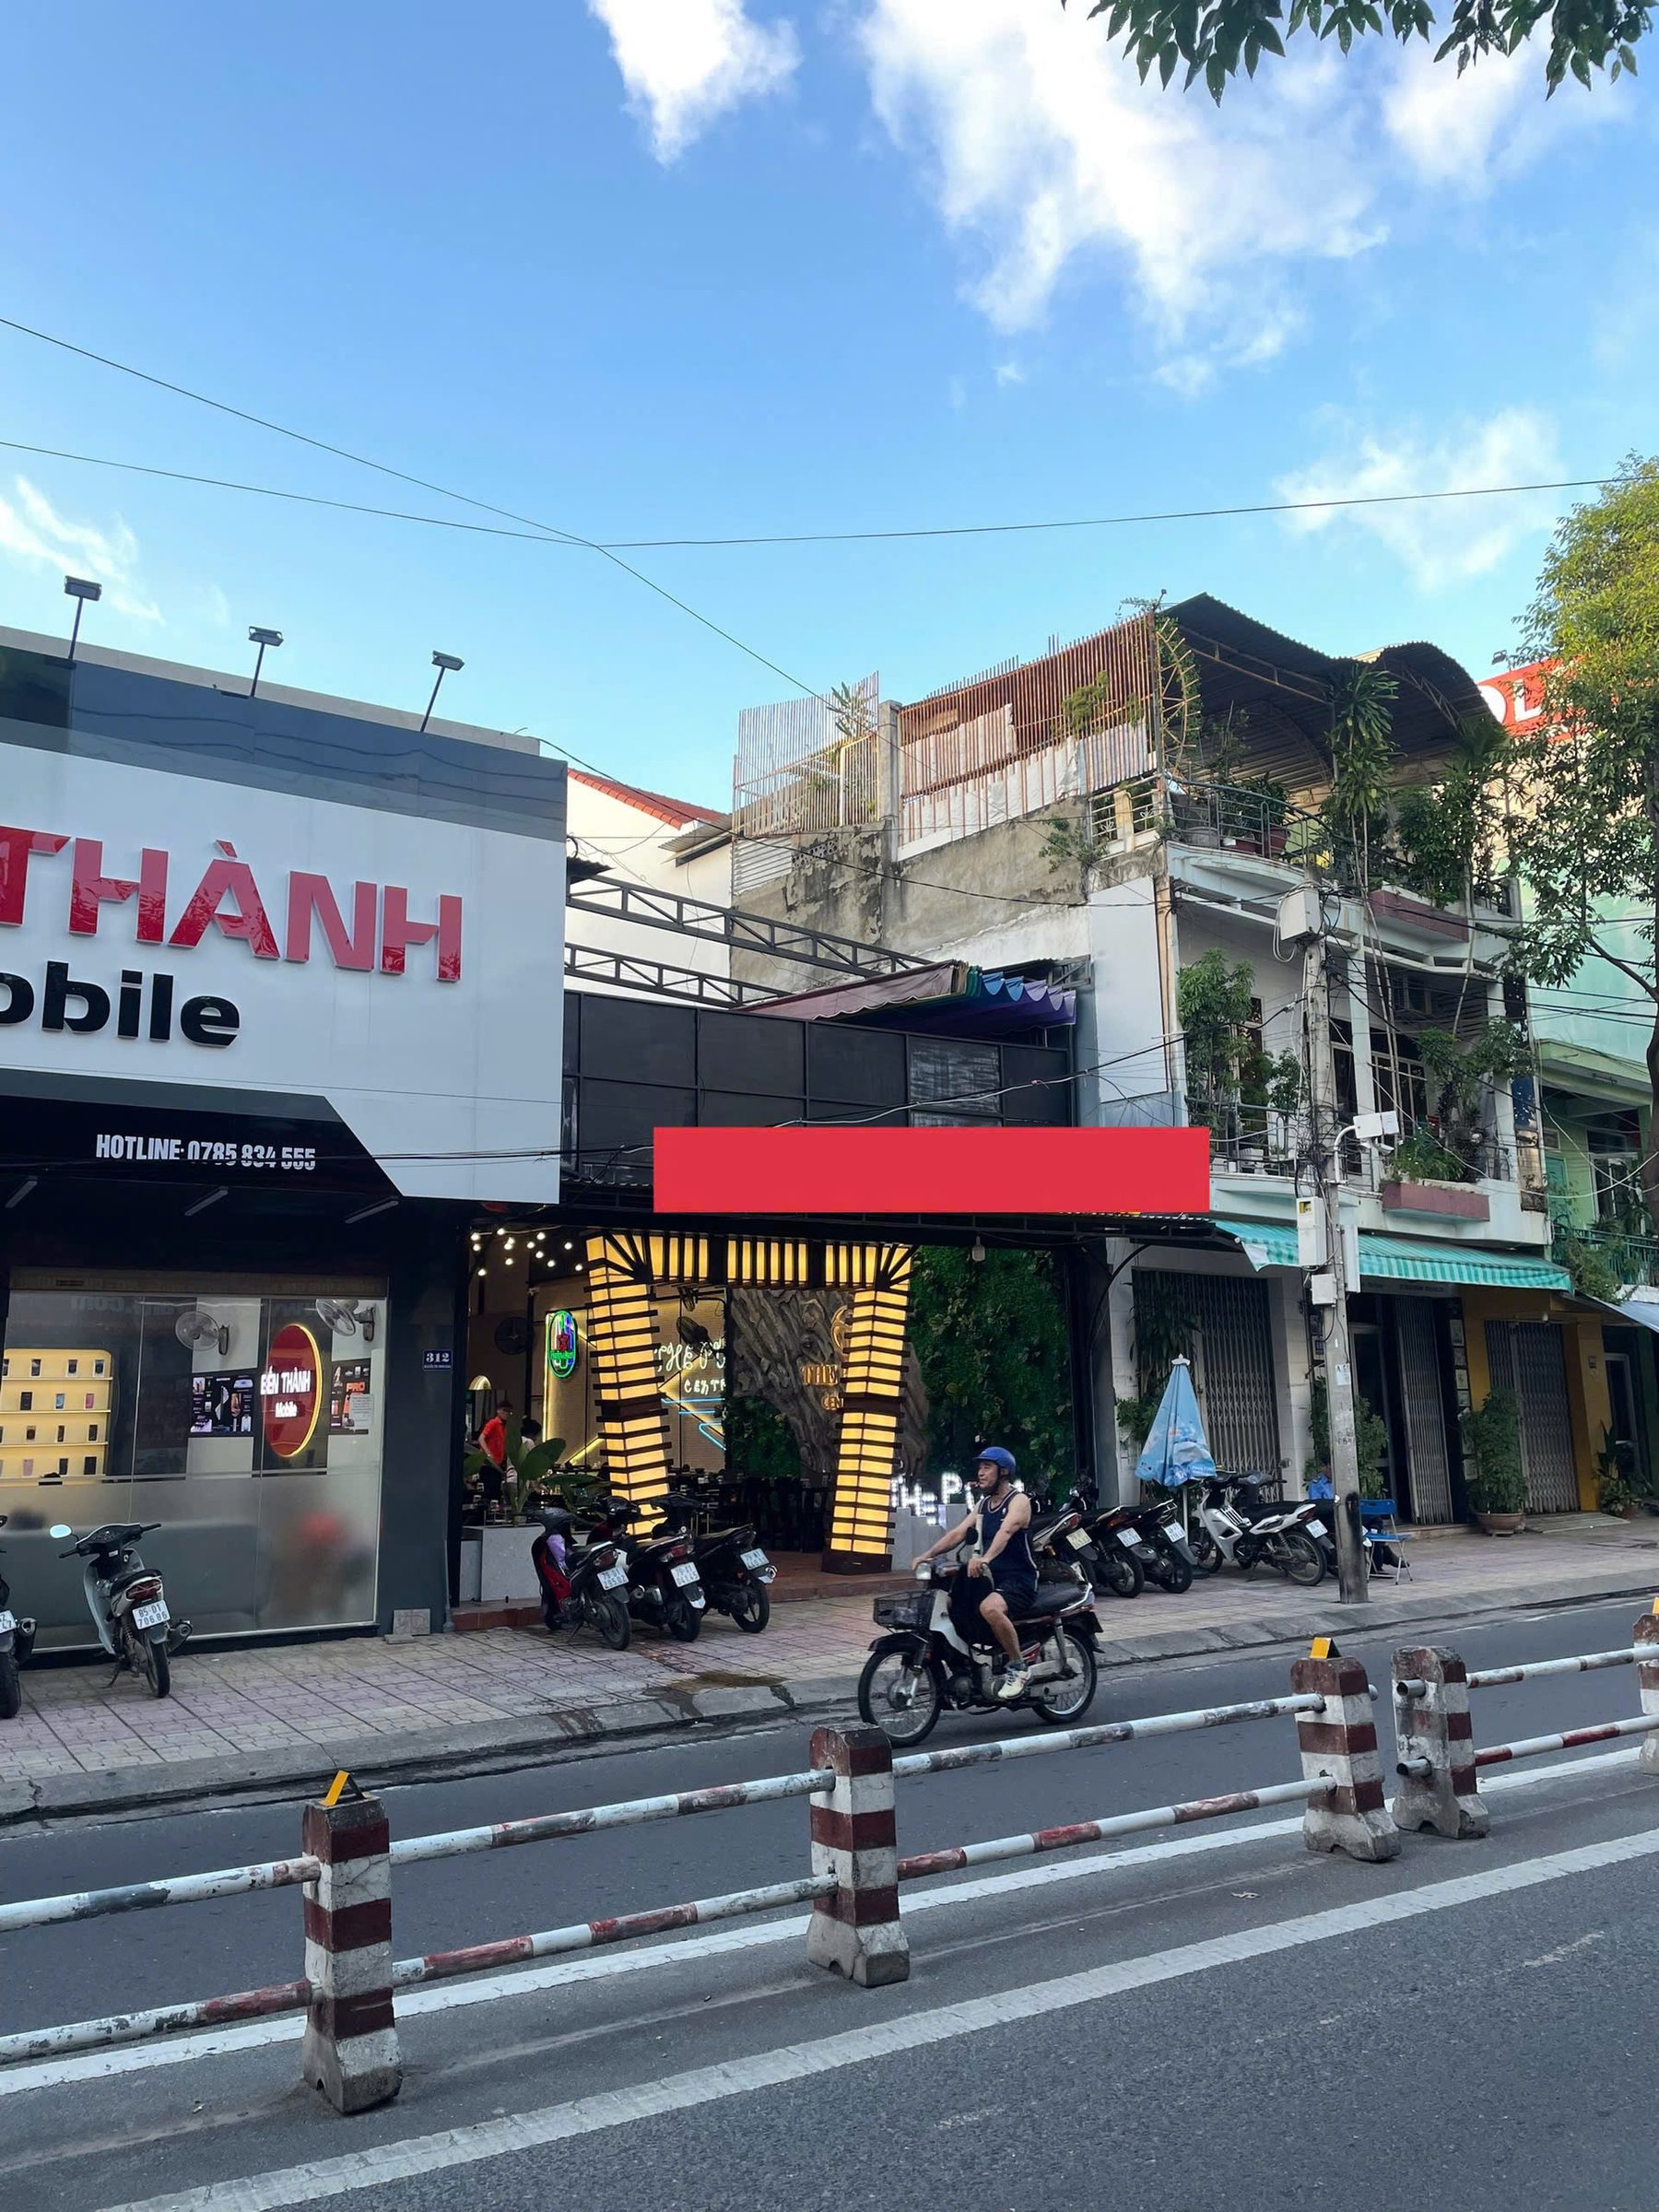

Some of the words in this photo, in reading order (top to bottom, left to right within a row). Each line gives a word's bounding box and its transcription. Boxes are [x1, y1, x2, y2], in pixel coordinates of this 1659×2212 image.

[0, 826, 463, 982] THÀNH
[241, 1144, 276, 1168] 834
[281, 1147, 316, 1171] 555
[426, 1352, 450, 1363] 312
[137, 1612, 168, 1628] 706.86
